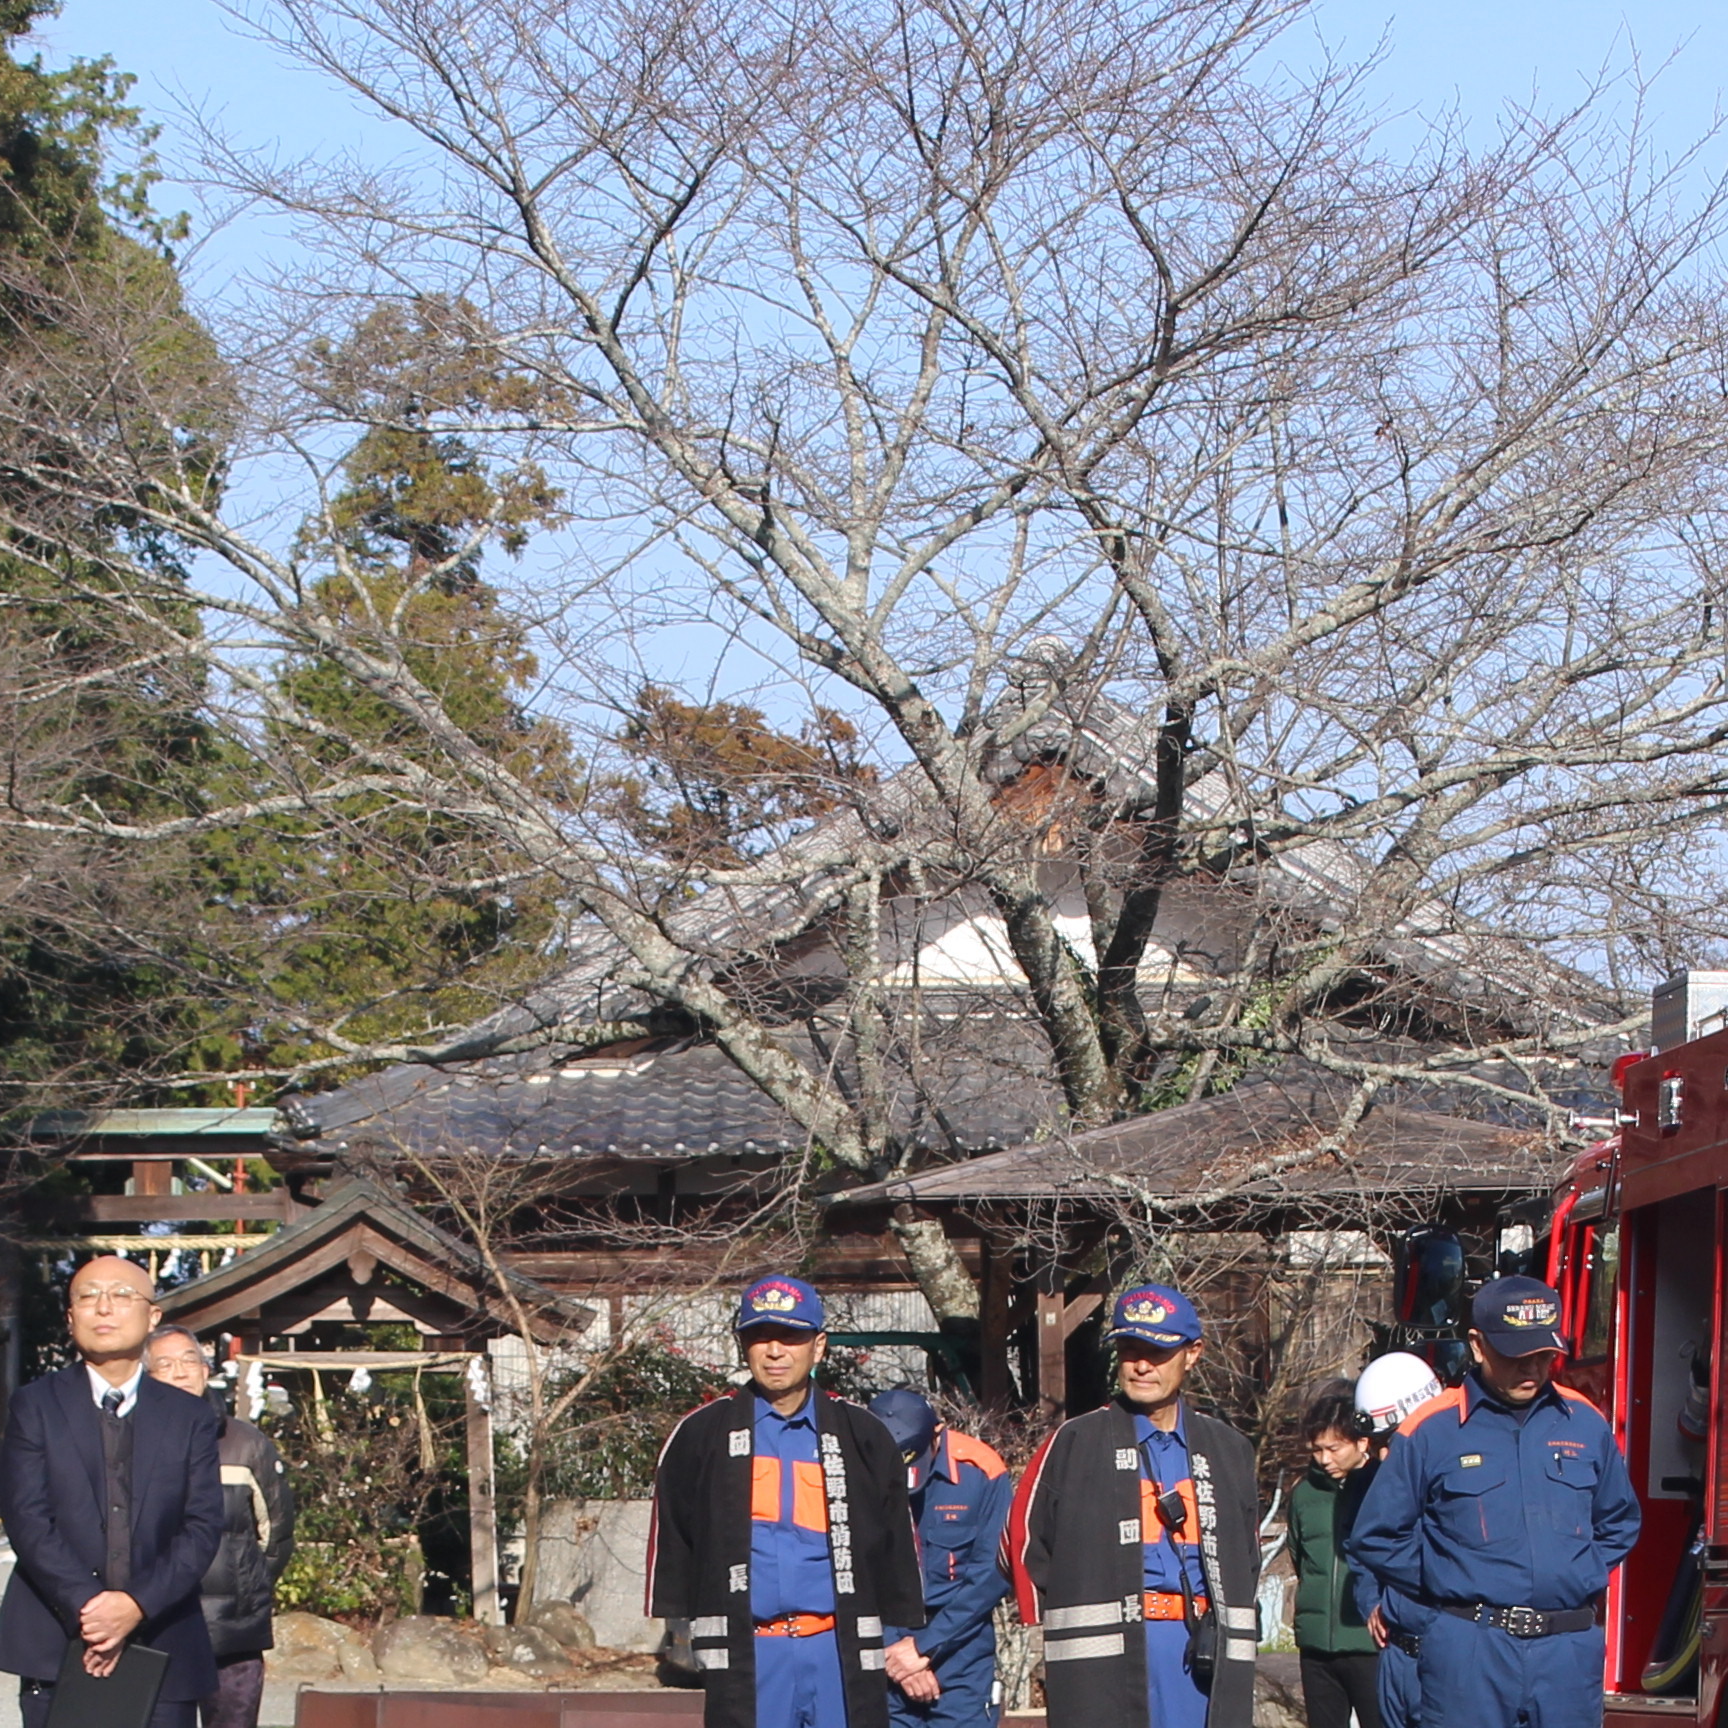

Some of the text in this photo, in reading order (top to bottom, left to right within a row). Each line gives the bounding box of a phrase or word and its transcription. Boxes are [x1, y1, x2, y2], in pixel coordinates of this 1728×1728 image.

[821, 1432, 856, 1595] 泉佐野市消防団
